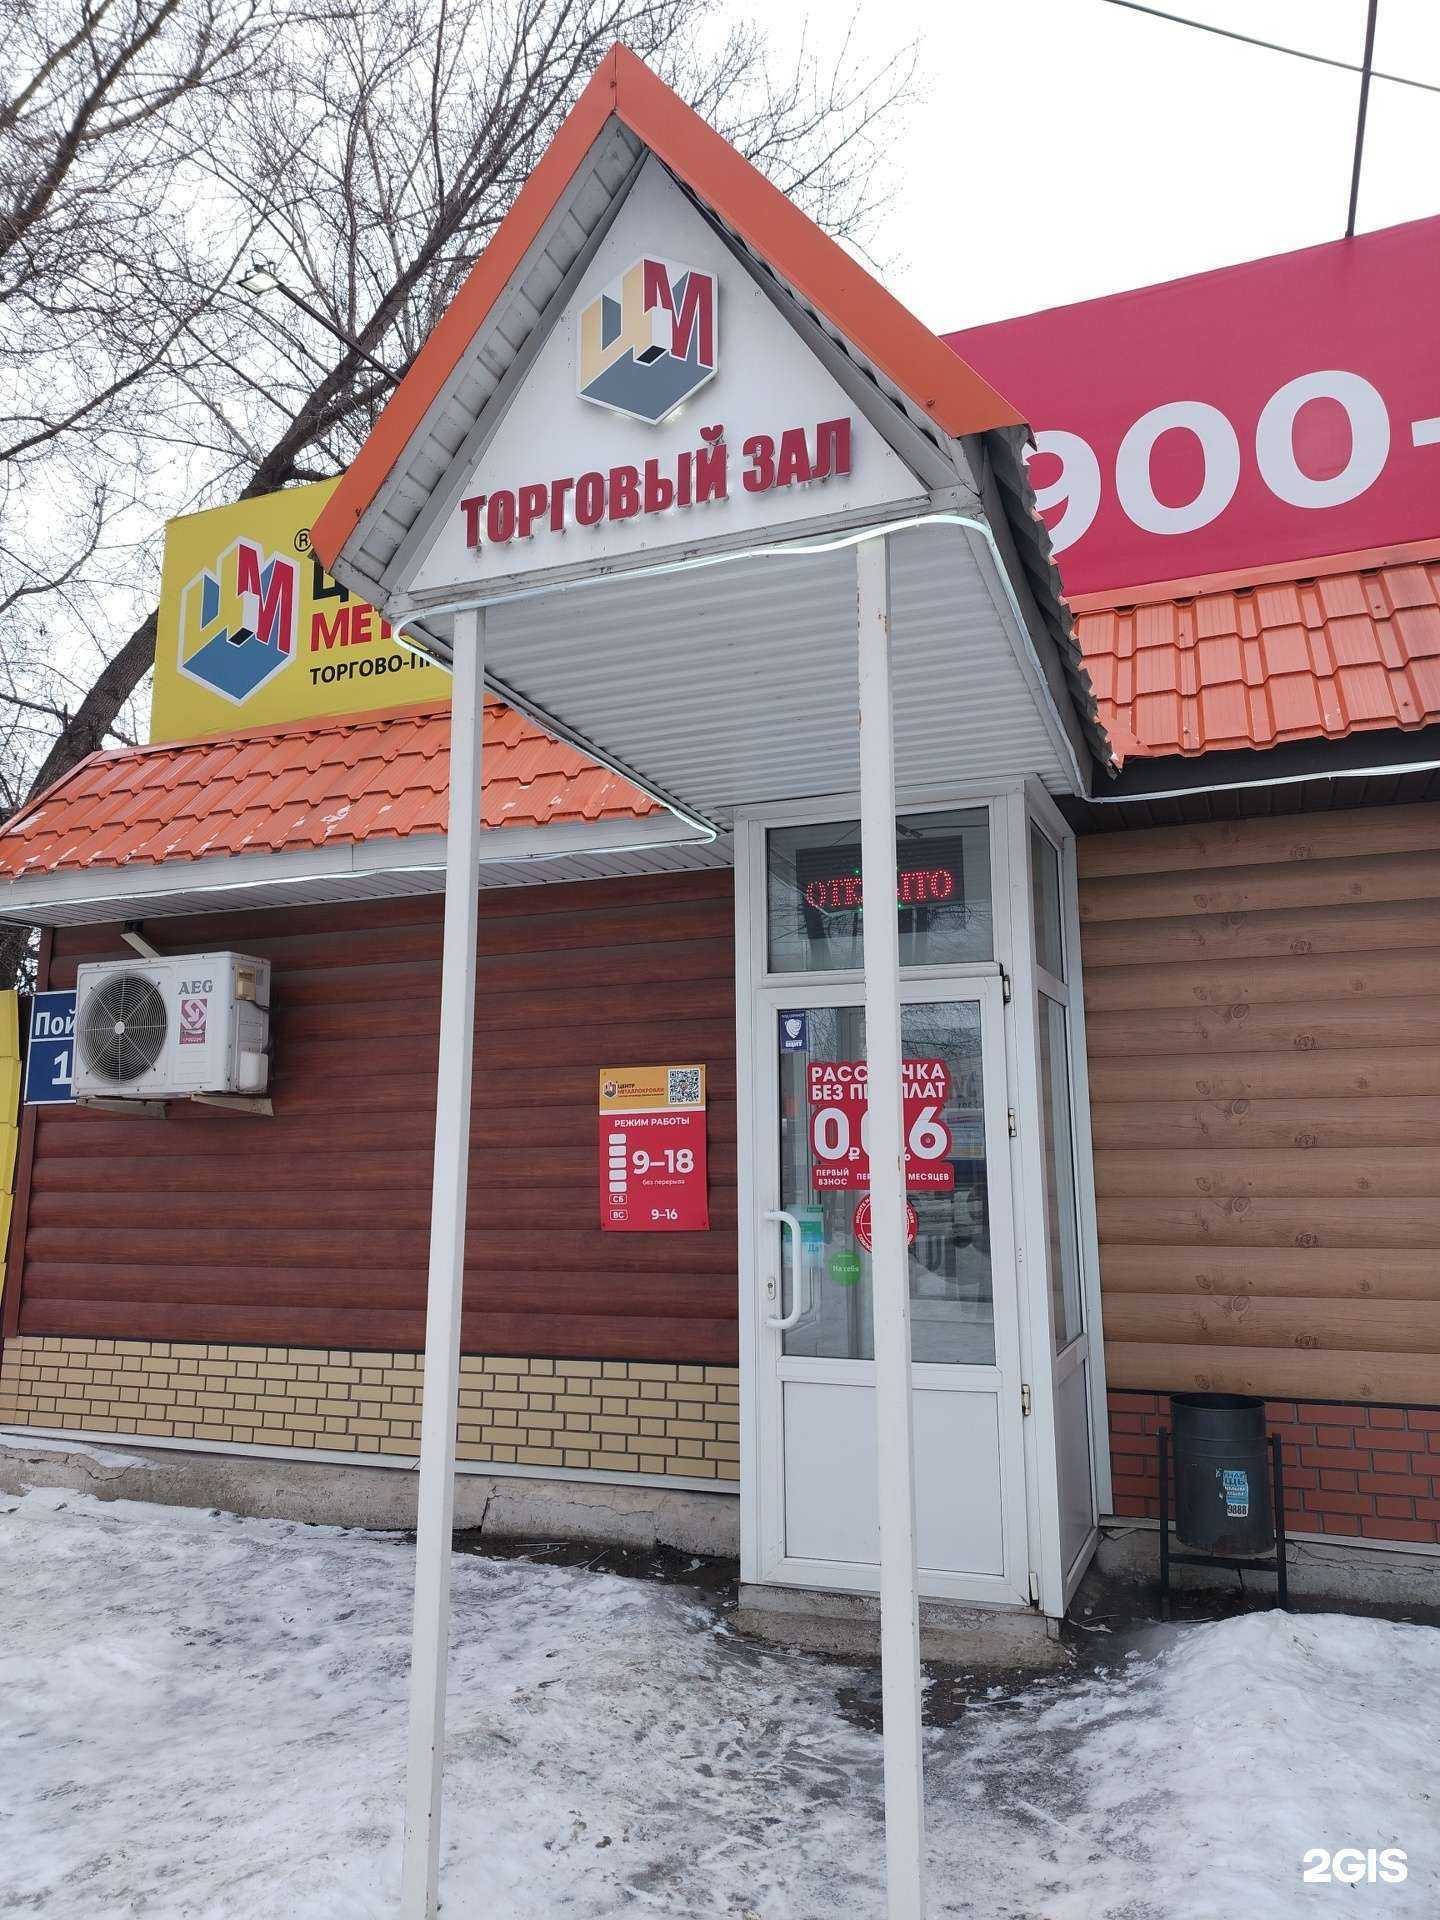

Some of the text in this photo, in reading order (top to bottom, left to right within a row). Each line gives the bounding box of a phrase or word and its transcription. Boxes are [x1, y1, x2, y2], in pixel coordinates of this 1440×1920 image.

[460, 417, 851, 549] ТОРГОВЫЙ ЗАЛ
[313, 560, 350, 603] Ц
[806, 869, 953, 908] ОТКТО
[178, 980, 213, 995] AEG
[811, 1063, 945, 1082] РАССЧКА
[812, 1084, 843, 1101] БЕЗ
[614, 1116, 690, 1128] РЕЖИМ РАБОТЫ
[816, 1168, 849, 1177] ПЕРВЫЙ
[908, 1173, 949, 1182] МЕСЯЦЕВ
[818, 1178, 848, 1186] ВЗНОС
[612, 1195, 624, 1203] СБ
[612, 1211, 624, 1219] ВС
